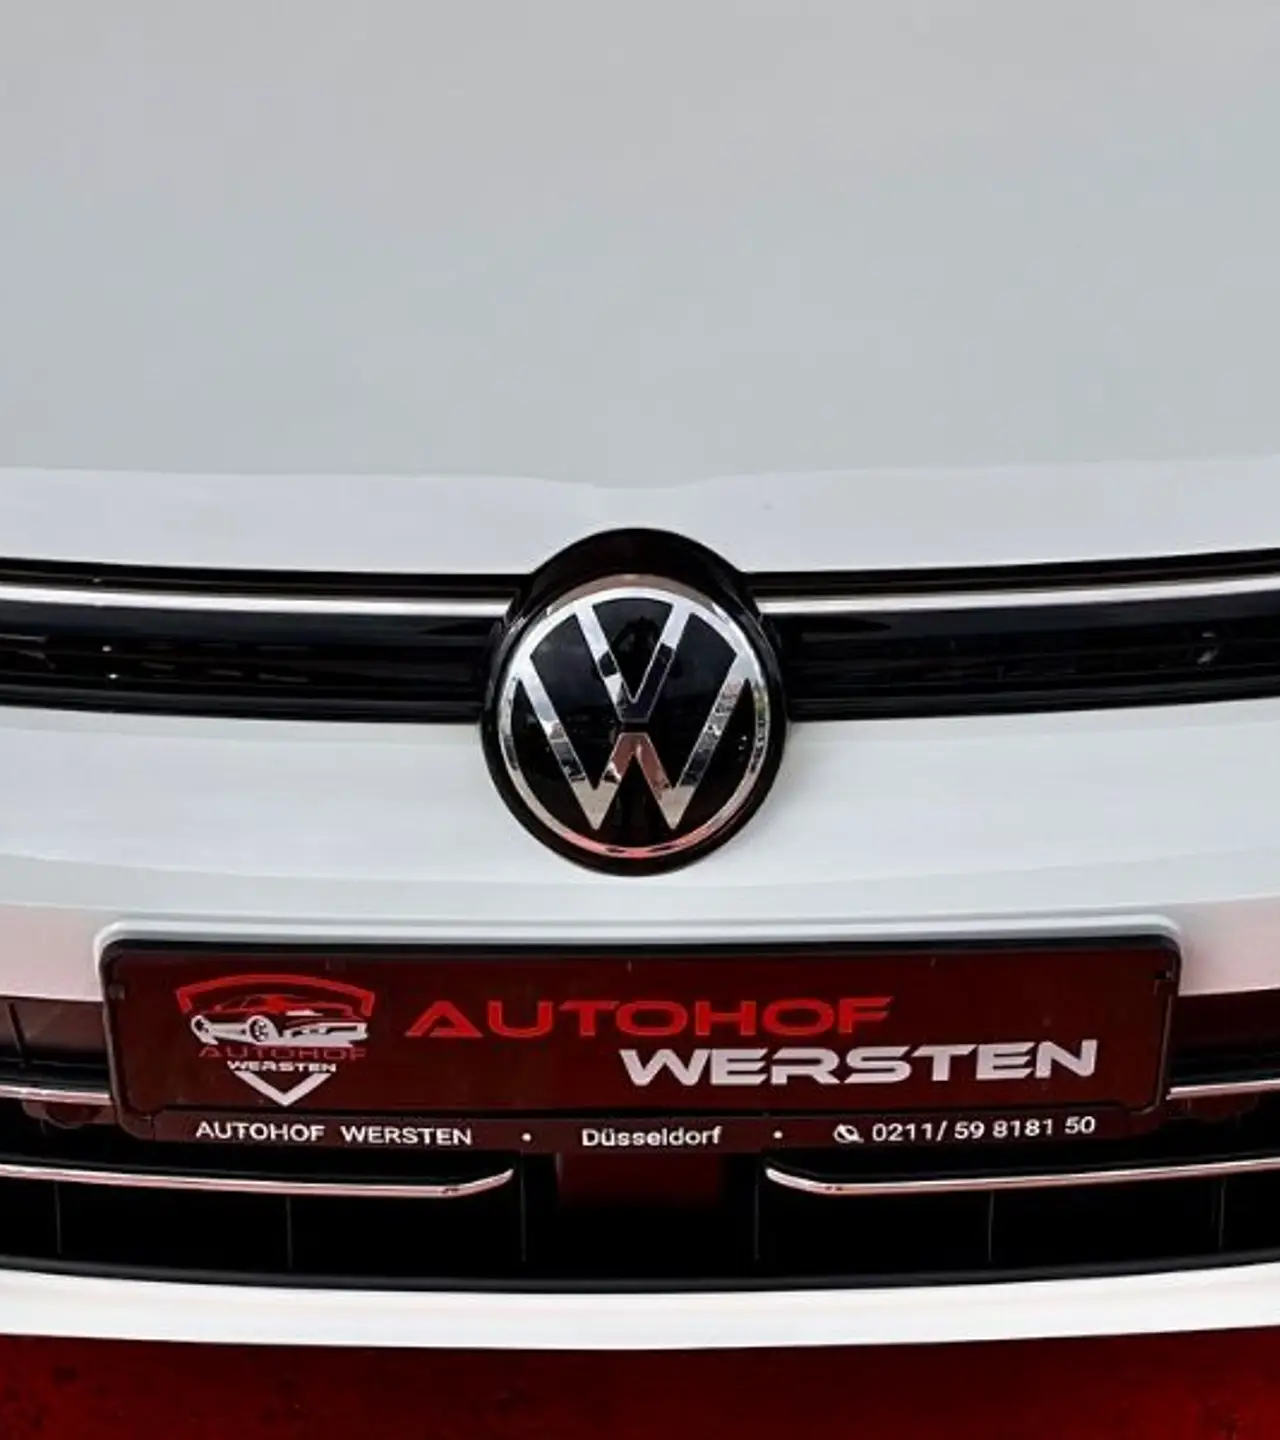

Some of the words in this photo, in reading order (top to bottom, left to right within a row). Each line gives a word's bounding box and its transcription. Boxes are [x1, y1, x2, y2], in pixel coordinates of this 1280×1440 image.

[405, 995, 893, 1040] AUTOHOF
[198, 1044, 367, 1061] AUTOHOF
[225, 1059, 338, 1073] WERSTEN
[618, 1038, 1099, 1087] WERSTEN
[195, 1120, 326, 1143] AUTOHOF
[339, 1124, 473, 1147] WERSTEN
[580, 1124, 723, 1147] Düsseldorf
[953, 1120, 986, 1141] 59
[991, 1117, 1054, 1140] 8181
[1063, 1114, 1097, 1136] 50
